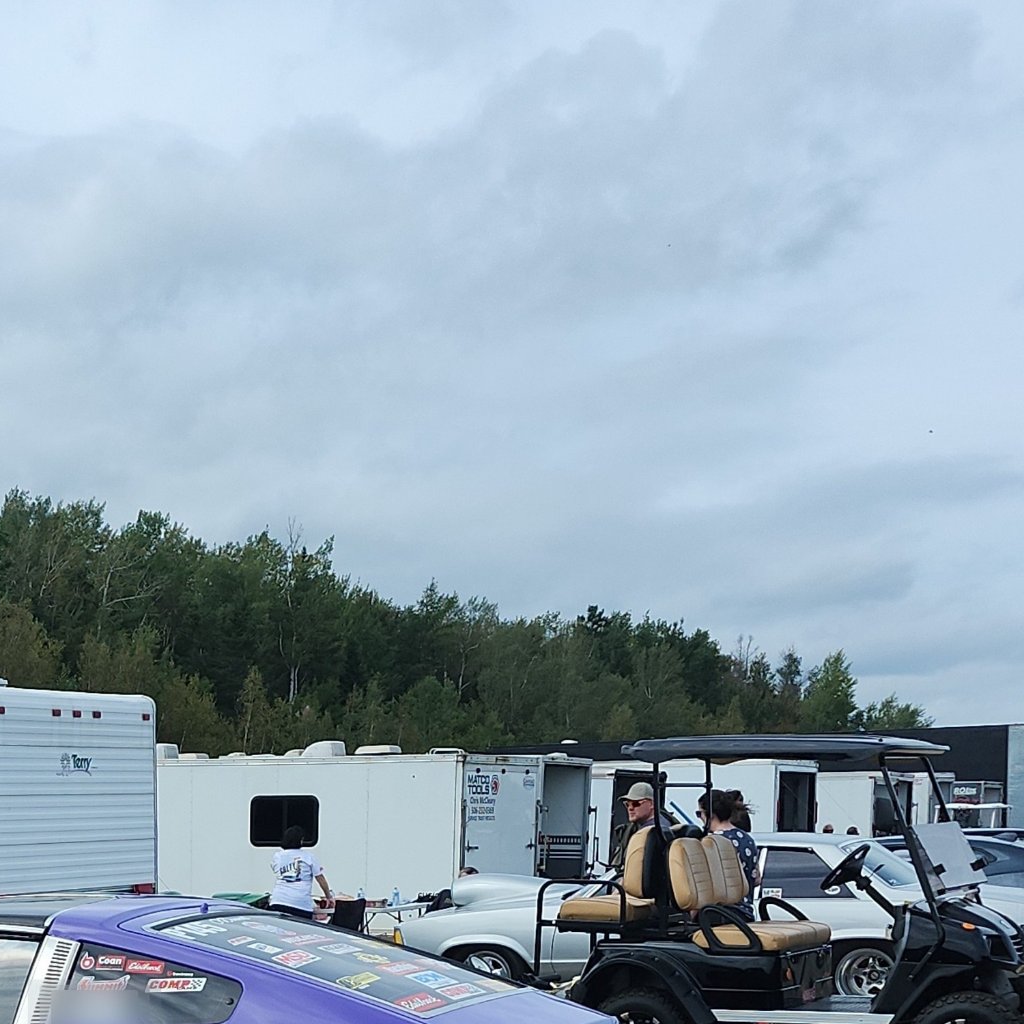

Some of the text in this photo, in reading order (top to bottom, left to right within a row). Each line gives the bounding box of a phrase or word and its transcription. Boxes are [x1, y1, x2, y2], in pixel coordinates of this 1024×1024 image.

[71, 755, 92, 772] Terry
[467, 775, 490, 784] MATCO
[467, 785, 490, 795] TOOLS
[98, 956, 122, 965] Coan
[149, 980, 191, 989] COMP
